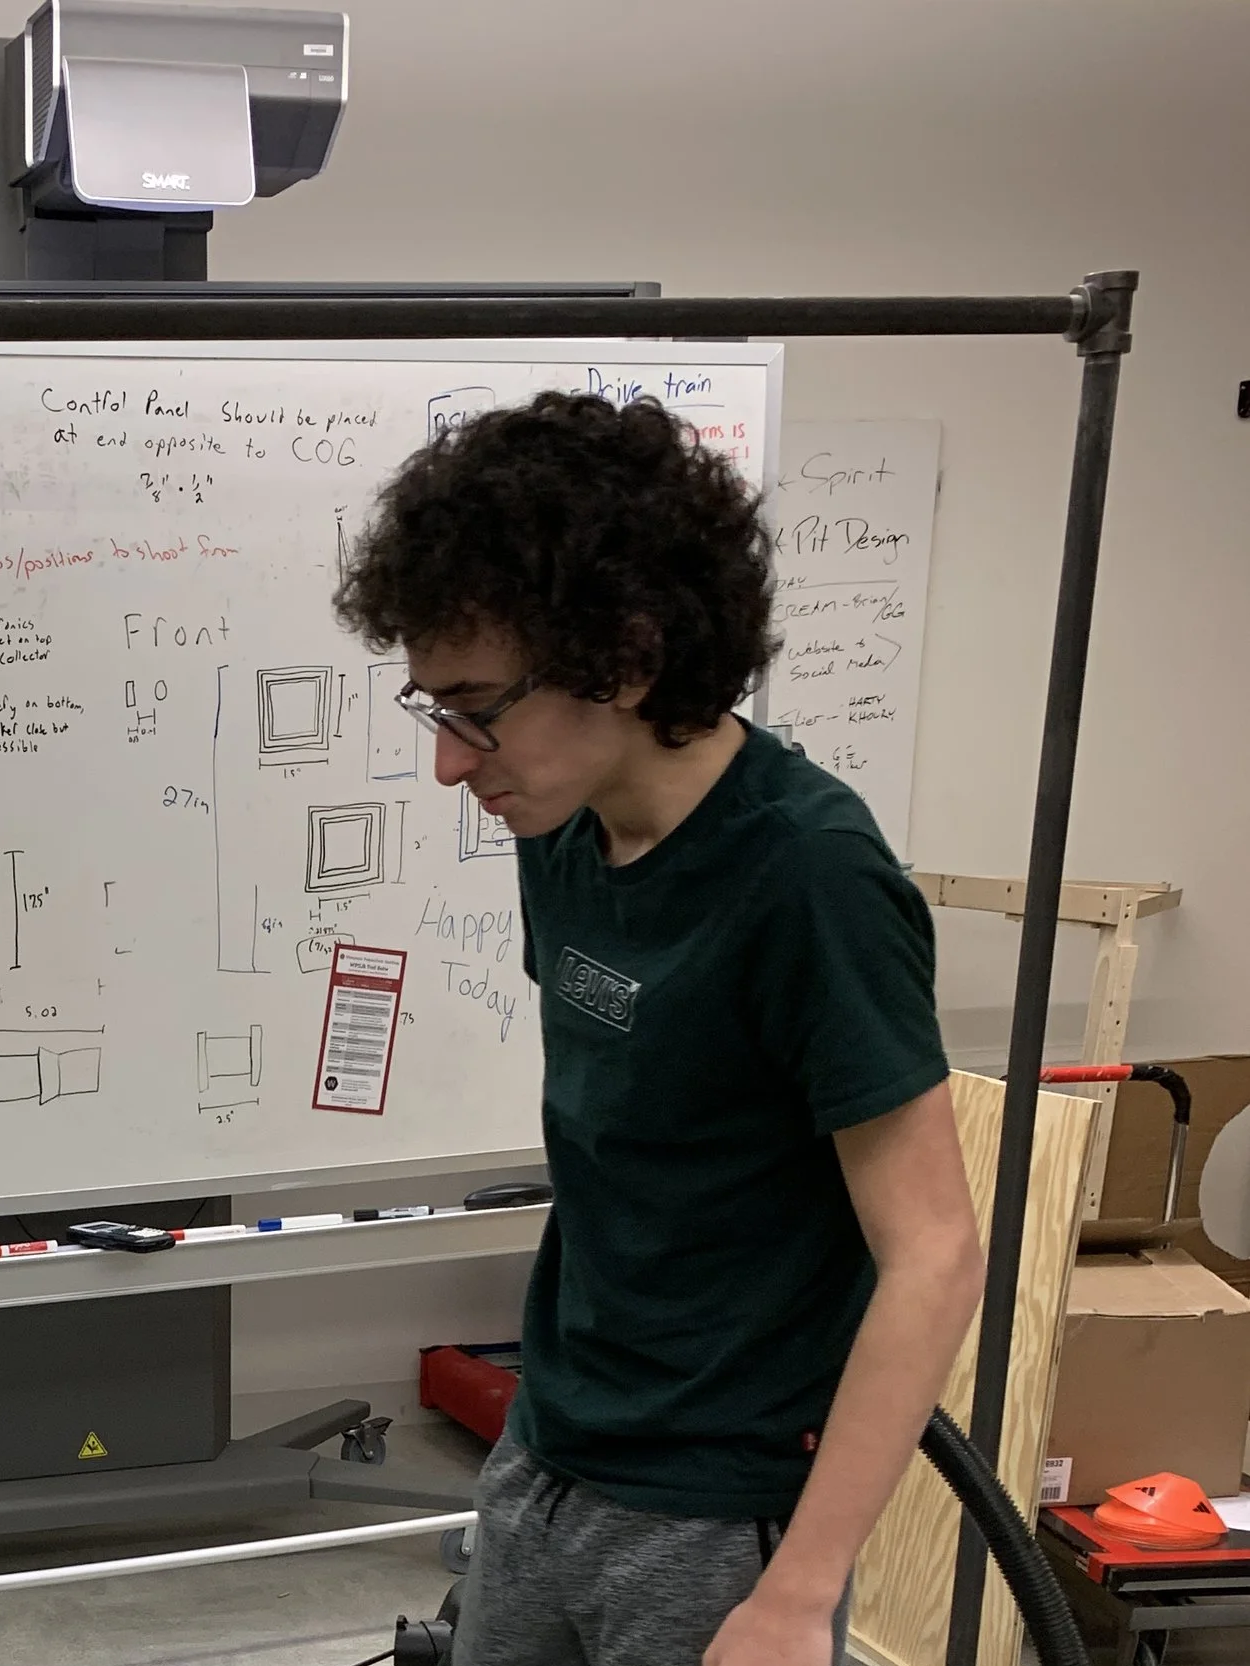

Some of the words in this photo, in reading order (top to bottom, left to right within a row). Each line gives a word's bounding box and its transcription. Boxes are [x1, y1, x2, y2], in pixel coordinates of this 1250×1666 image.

[142, 172, 190, 190] SMART
[588, 367, 642, 403] Drive
[664, 372, 712, 398] train
[41, 387, 126, 415] Control
[145, 389, 189, 418] Panel
[297, 408, 317, 426] be
[326, 410, 376, 433] placed
[54, 423, 77, 444] at
[97, 432, 127, 447] end
[145, 433, 226, 457] opposite
[246, 438, 266, 459] to
[801, 452, 896, 496] Spirit
[110, 538, 129, 558] to
[136, 536, 188, 561] shoot
[791, 515, 829, 555] Pit
[835, 517, 910, 566] Design
[35, 634, 52, 646] top
[125, 613, 231, 650] Front
[790, 660, 835, 682] Social
[25, 699, 38, 708] on
[52, 722, 69, 734] but
[162, 785, 209, 815] 27in
[415, 897, 513, 962] Happy
